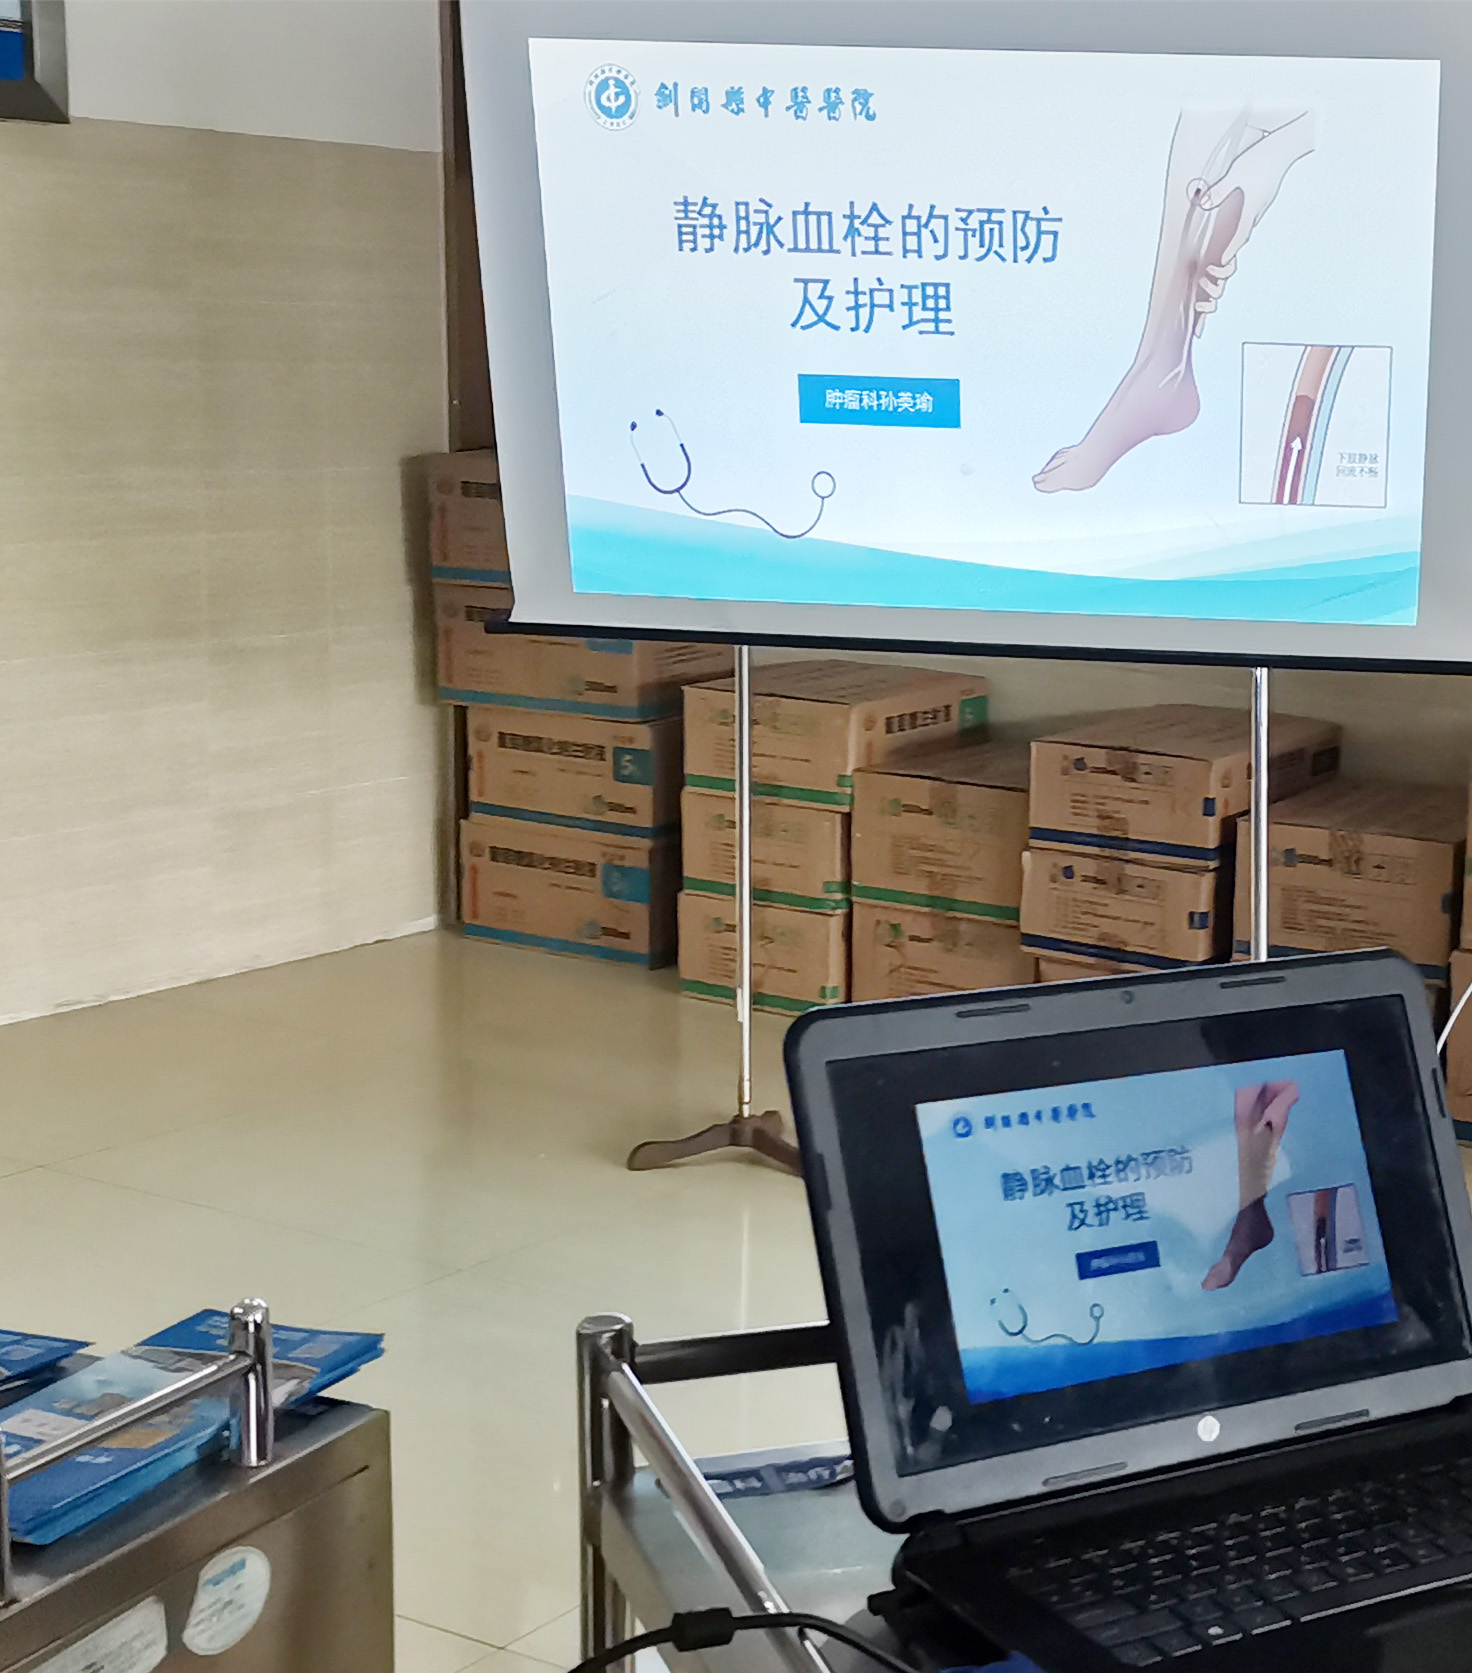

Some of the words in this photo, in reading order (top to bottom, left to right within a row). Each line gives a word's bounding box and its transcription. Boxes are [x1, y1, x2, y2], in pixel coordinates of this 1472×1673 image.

[673, 195, 1063, 264] 静脉血栓的预防
[789, 276, 956, 337] 及护理
[1001, 1146, 1194, 1202] 静脉血栓的预防
[1065, 1191, 1151, 1232] 及护理
